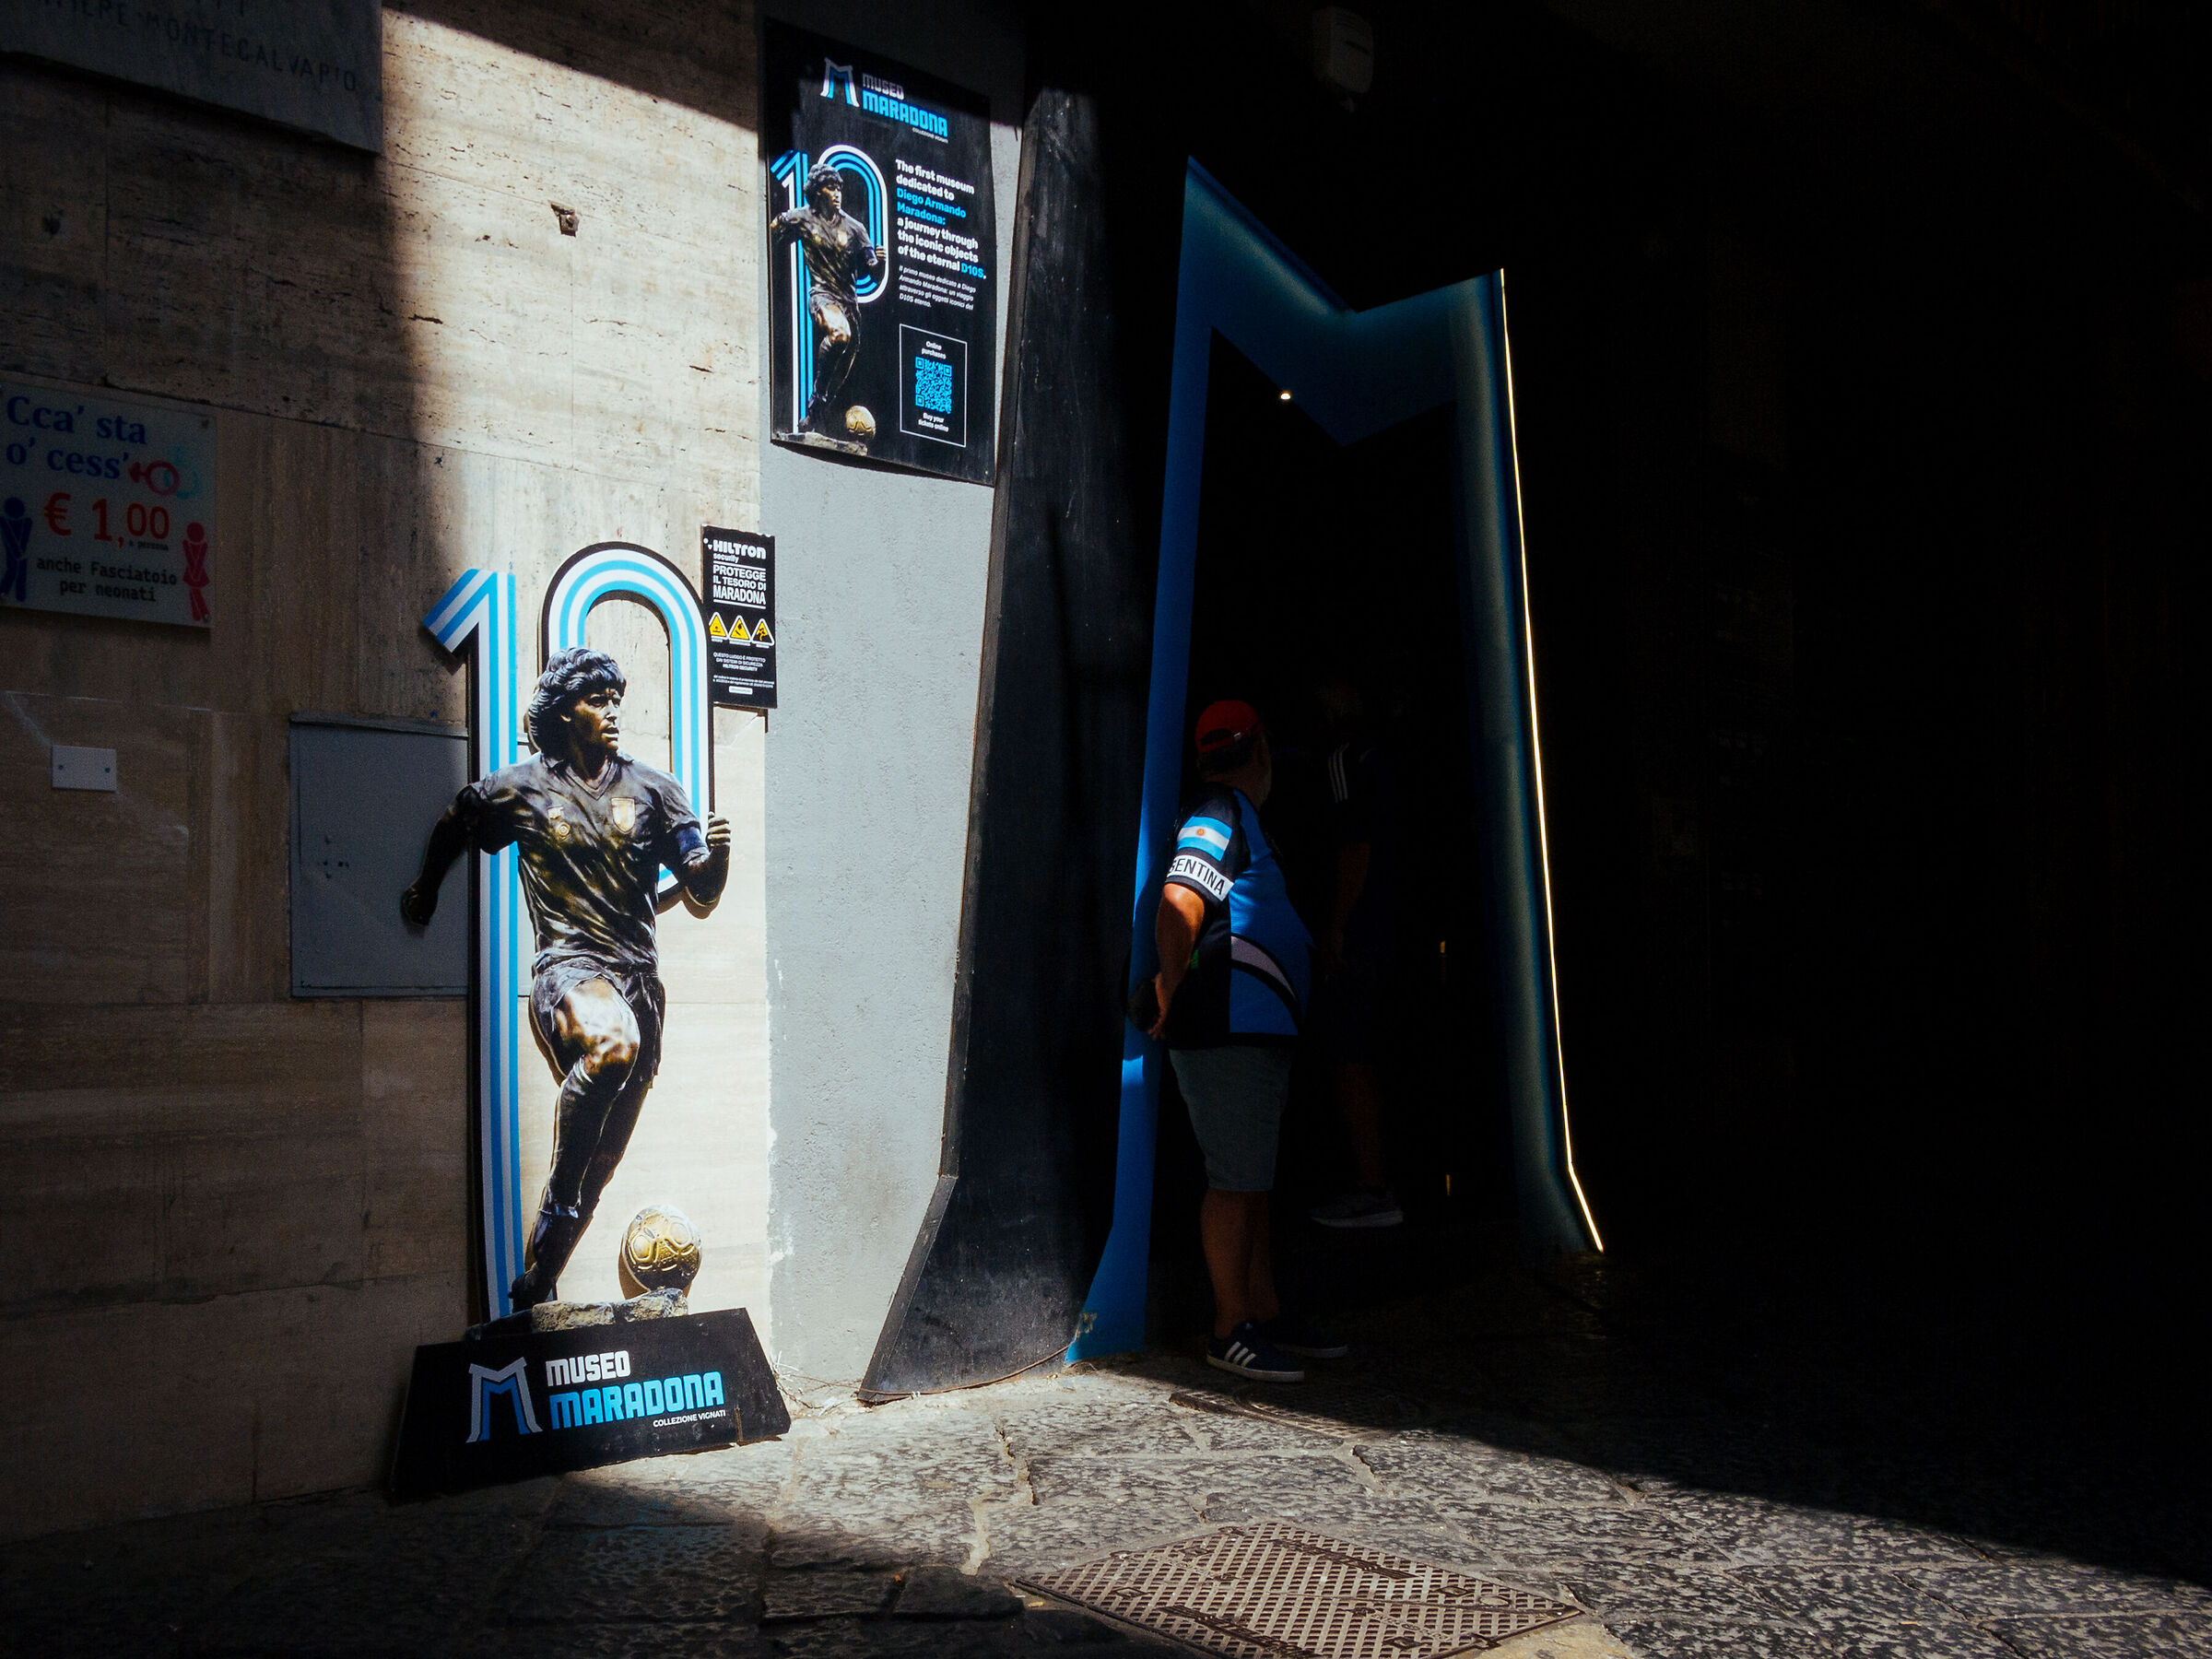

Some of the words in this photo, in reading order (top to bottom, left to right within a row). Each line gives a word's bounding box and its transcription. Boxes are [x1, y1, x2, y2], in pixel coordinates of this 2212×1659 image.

[863, 73, 904, 100] MUSEO
[863, 89, 948, 137] MARADONA
[896, 159, 913, 174] The
[915, 165, 935, 182] first
[936, 174, 974, 194] museum
[896, 174, 943, 197] dedicated
[944, 188, 955, 201] to
[897, 187, 924, 205] Diego
[924, 196, 967, 218] Armando
[897, 201, 947, 226] Maradona:
[897, 218, 904, 227] a
[904, 217, 940, 240] journey
[941, 229, 979, 250] through
[897, 229, 914, 243] the
[915, 234, 944, 253] iconic
[945, 245, 979, 264] objects
[898, 245, 909, 255] of
[909, 247, 926, 261] the
[926, 253, 960, 272] eternal
[960, 262, 986, 279] D10S.
[97, 416, 147, 444] sta
[92, 499, 170, 548] 1,00
[37, 558, 81, 573] anche
[91, 561, 177, 584] Fasciatoio
[713, 564, 766, 582] PROTEGGE
[713, 575, 721, 584] IL
[723, 577, 756, 590] TESORO
[758, 582, 766, 591] DI
[60, 581, 86, 594] per
[96, 583, 156, 601] neonati
[713, 584, 766, 605] MARADONA
[546, 1350, 631, 1387] MUSEO
[549, 1371, 724, 1430] MARADONA
[653, 1413, 698, 1428] COLLEZIONE
[698, 1409, 726, 1422] VIGNATI
